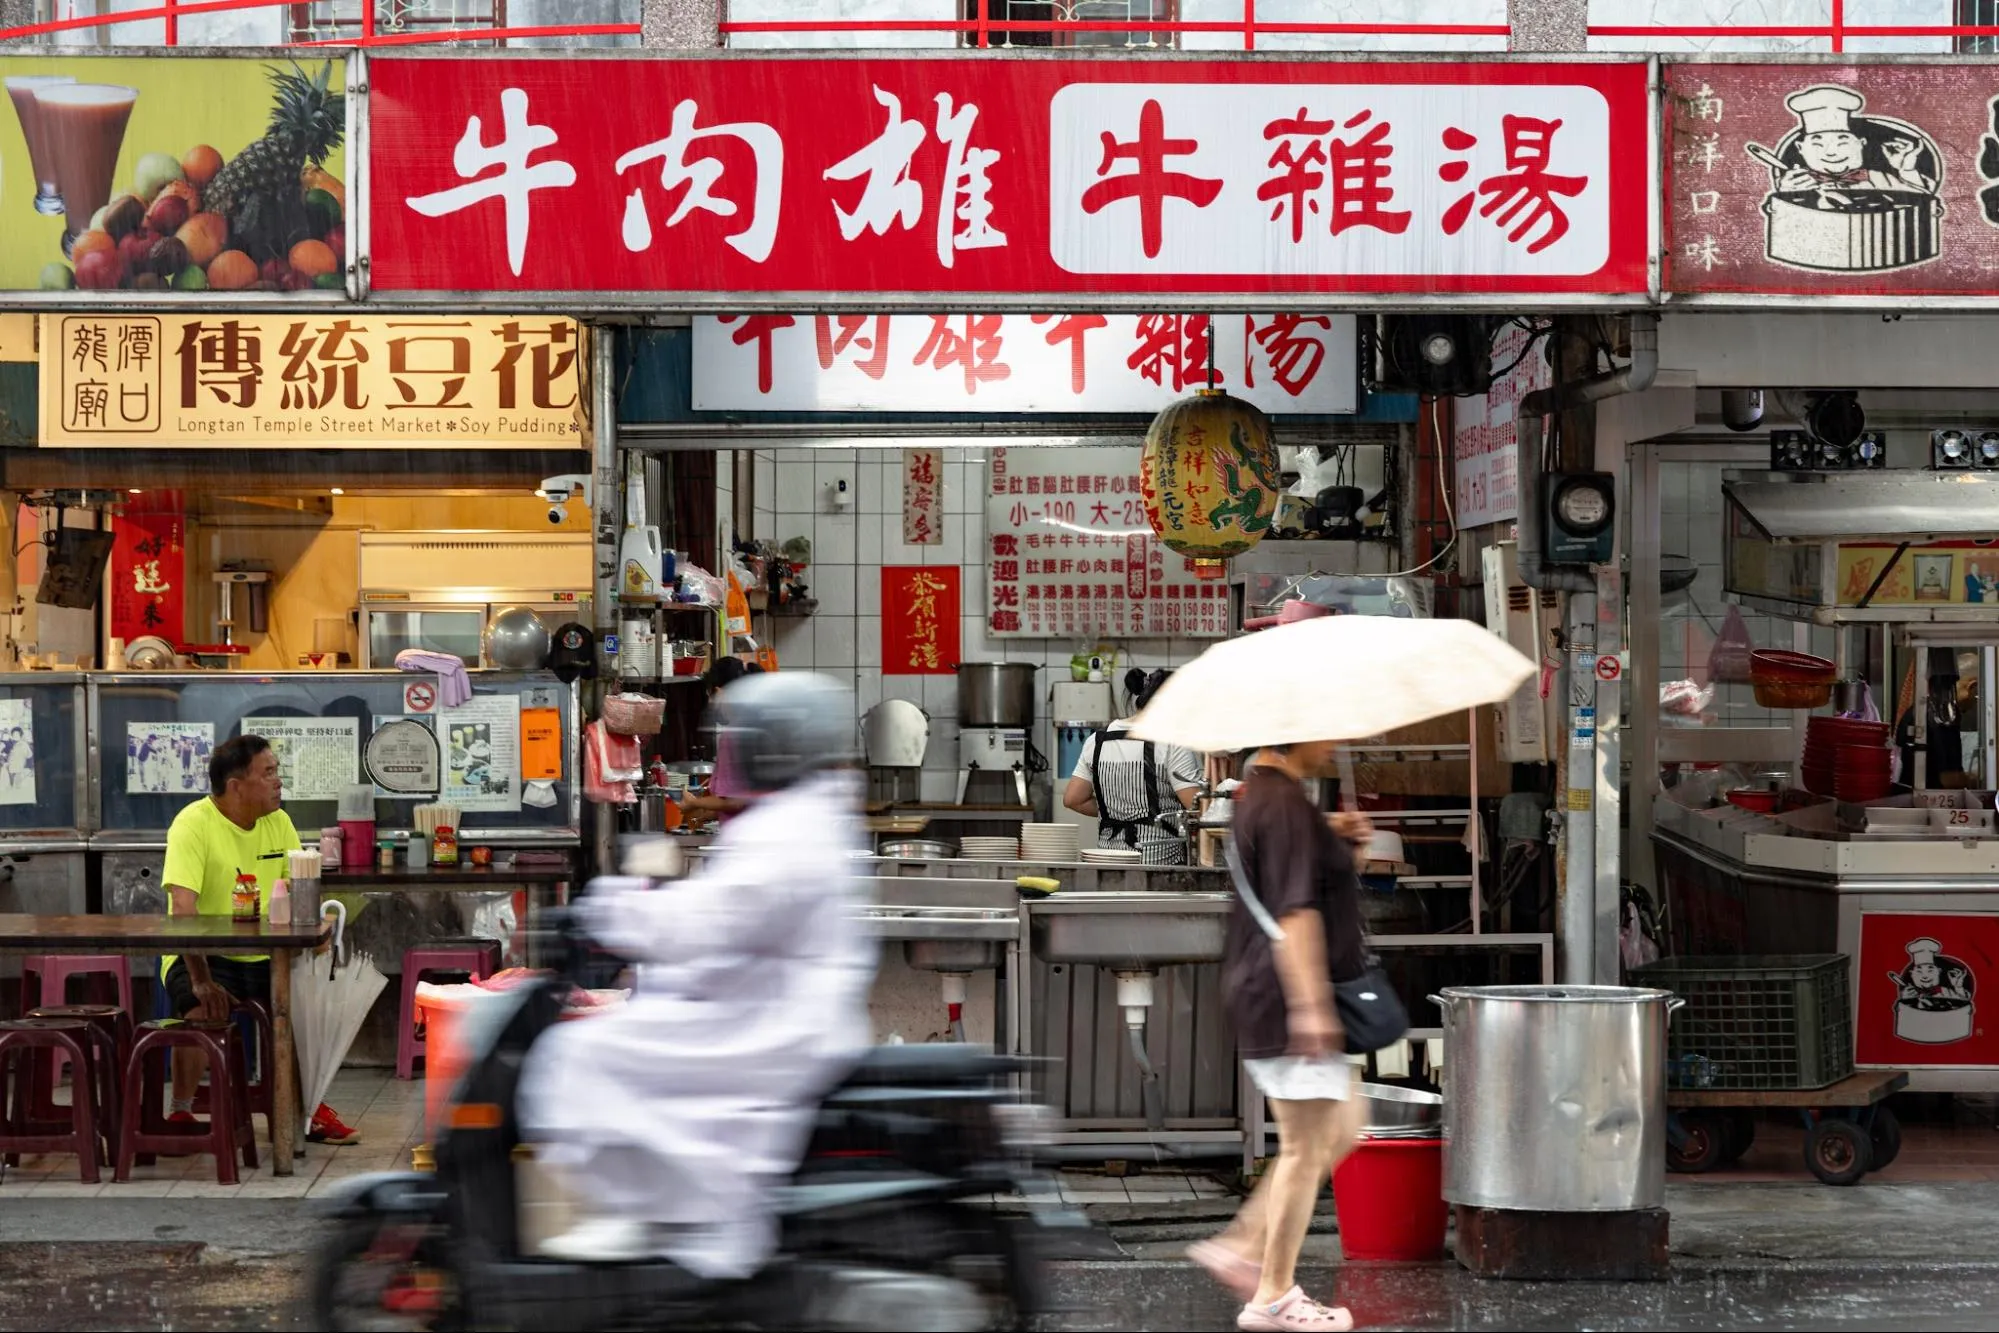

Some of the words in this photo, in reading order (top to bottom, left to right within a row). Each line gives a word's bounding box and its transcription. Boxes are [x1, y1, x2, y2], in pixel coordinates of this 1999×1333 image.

[406, 84, 1007, 276] 牛肉雄
[1082, 99, 1588, 260] 牛雜湯
[1687, 84, 1724, 271] 南洋口味
[174, 319, 577, 410] 傳統豆花
[178, 416, 245, 433] Longtan
[253, 416, 313, 434] Temple
[320, 416, 373, 432] Street
[381, 416, 441, 432] Market
[460, 416, 490, 434] Soy
[498, 416, 566, 434] Pudding
[1184, 424, 1211, 526] 吉祥如意
[1950, 810, 1968, 824] 25
